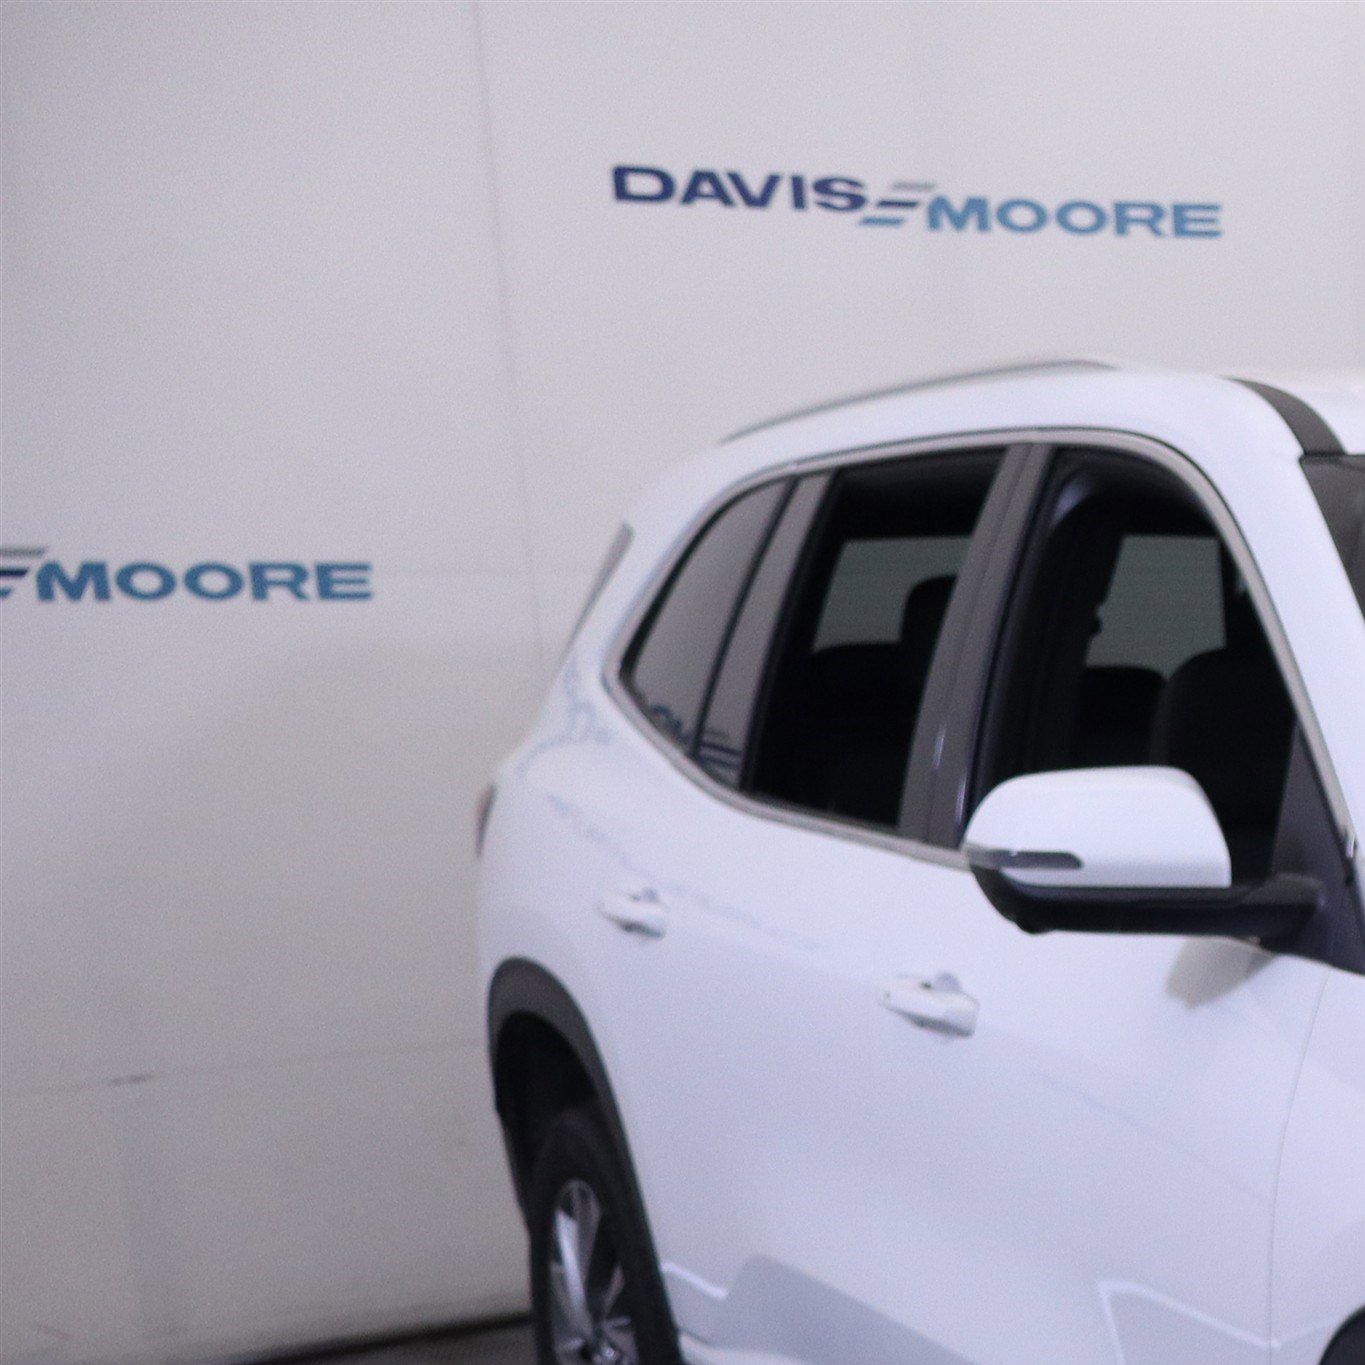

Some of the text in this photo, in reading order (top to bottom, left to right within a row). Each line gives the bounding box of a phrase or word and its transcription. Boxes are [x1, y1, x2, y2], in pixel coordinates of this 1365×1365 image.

[612, 165, 1223, 239] DAVIS MOORE
[36, 560, 373, 602] MOORE
